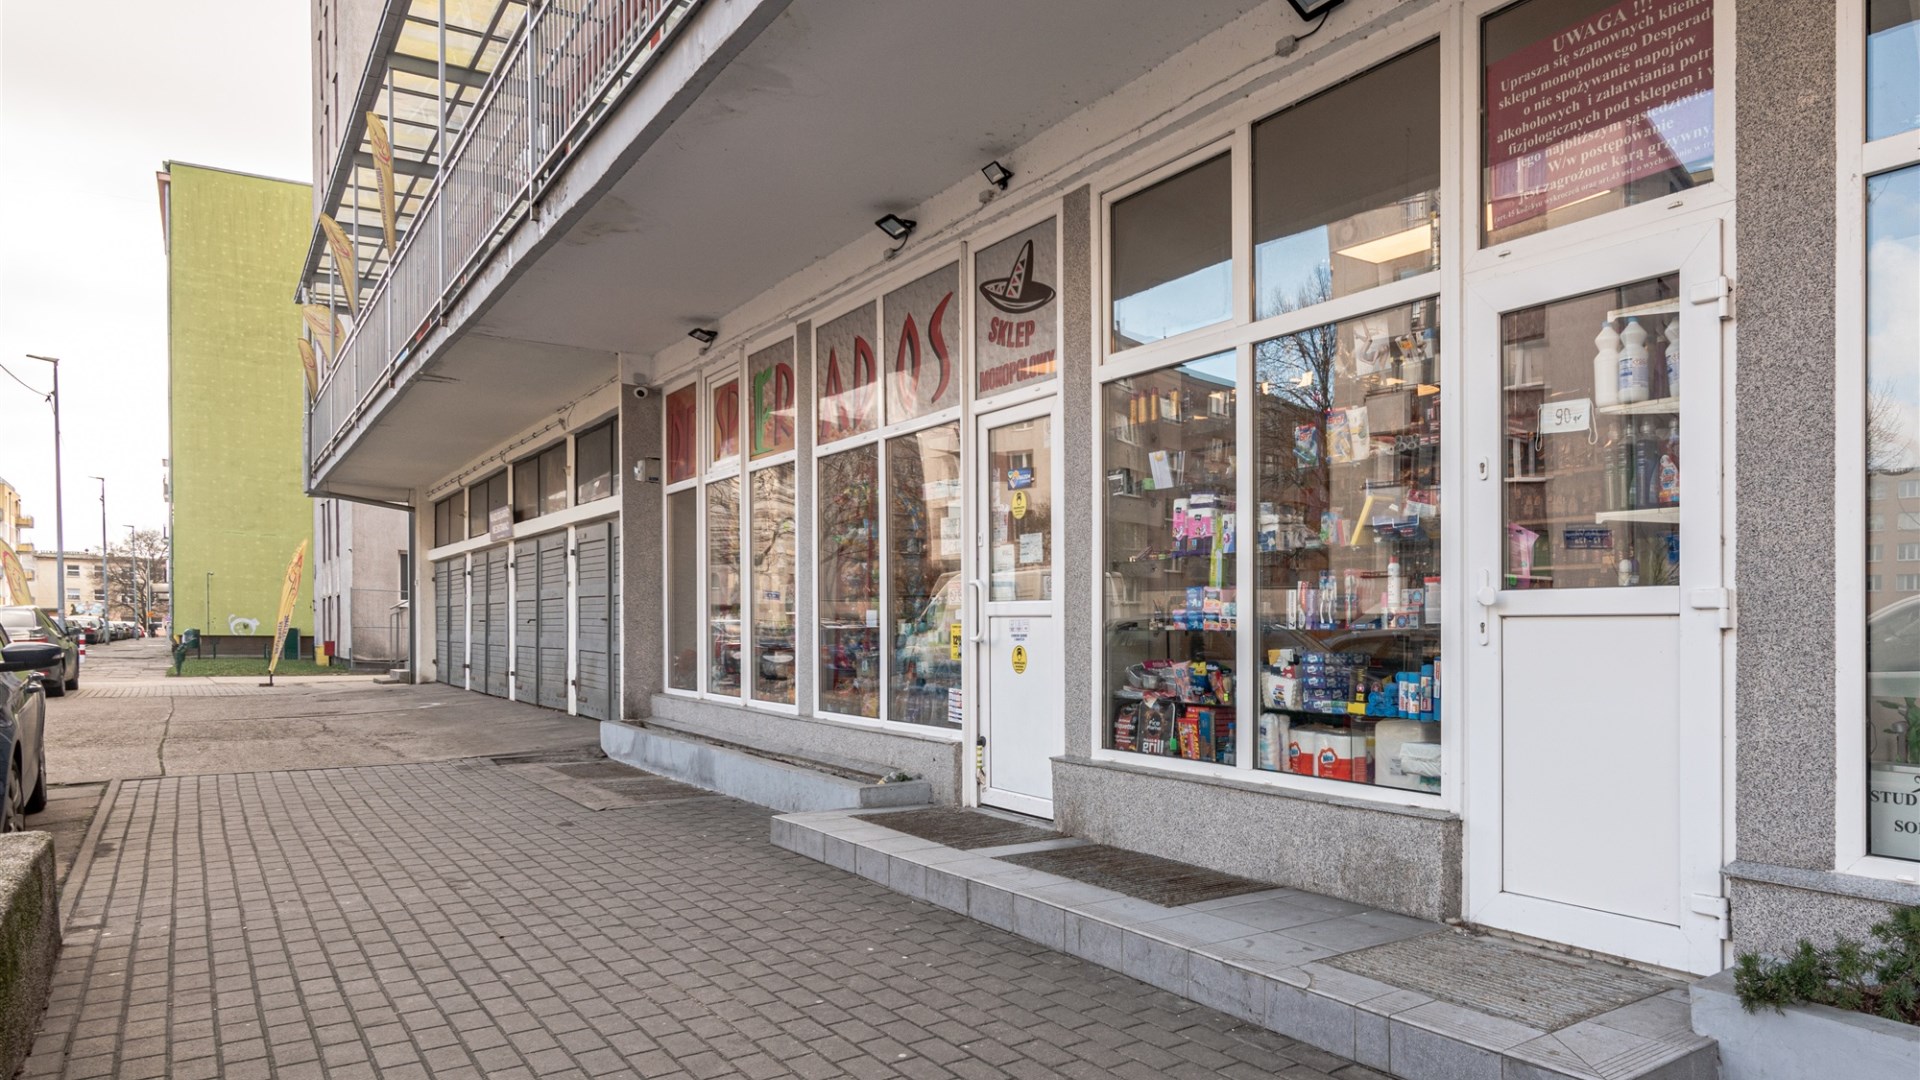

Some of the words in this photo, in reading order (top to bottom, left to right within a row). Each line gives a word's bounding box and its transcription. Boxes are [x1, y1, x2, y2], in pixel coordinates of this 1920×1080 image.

[1500, 64, 1550, 92] Uprasza
[1552, 52, 1570, 68] się
[1572, 16, 1654, 56] szanownych
[1552, 8, 1628, 53] UWAGA
[1496, 102, 1580, 144] alkoholowych
[1588, 96, 1592, 106] i
[1596, 62, 1675, 103] załatwiania
[1680, 48, 1714, 72] potr
[1498, 86, 1537, 110] sklepu
[1540, 42, 1638, 95] monopolowego
[1523, 105, 1530, 116] o
[1534, 96, 1552, 112] nie
[1555, 63, 1631, 106] spożywanie
[1635, 34, 1696, 68] napojów
[1508, 110, 1600, 156] fizjologicznych
[1604, 96, 1630, 120] pod
[1634, 74, 1693, 105] sklepem
[1698, 67, 1702, 80] i
[1516, 152, 1541, 174] jego
[1545, 121, 1621, 158] najbliższym
[1547, 154, 1577, 172] W/w
[1581, 119, 1674, 164] postępowanie
[1518, 185, 1542, 205] jest
[1544, 162, 1608, 192] zagrożone
[1612, 148, 1644, 168] karą
[988, 316, 1036, 348] SKLEP
[1142, 738, 1164, 754] grill
[1894, 820, 1920, 834] SO
